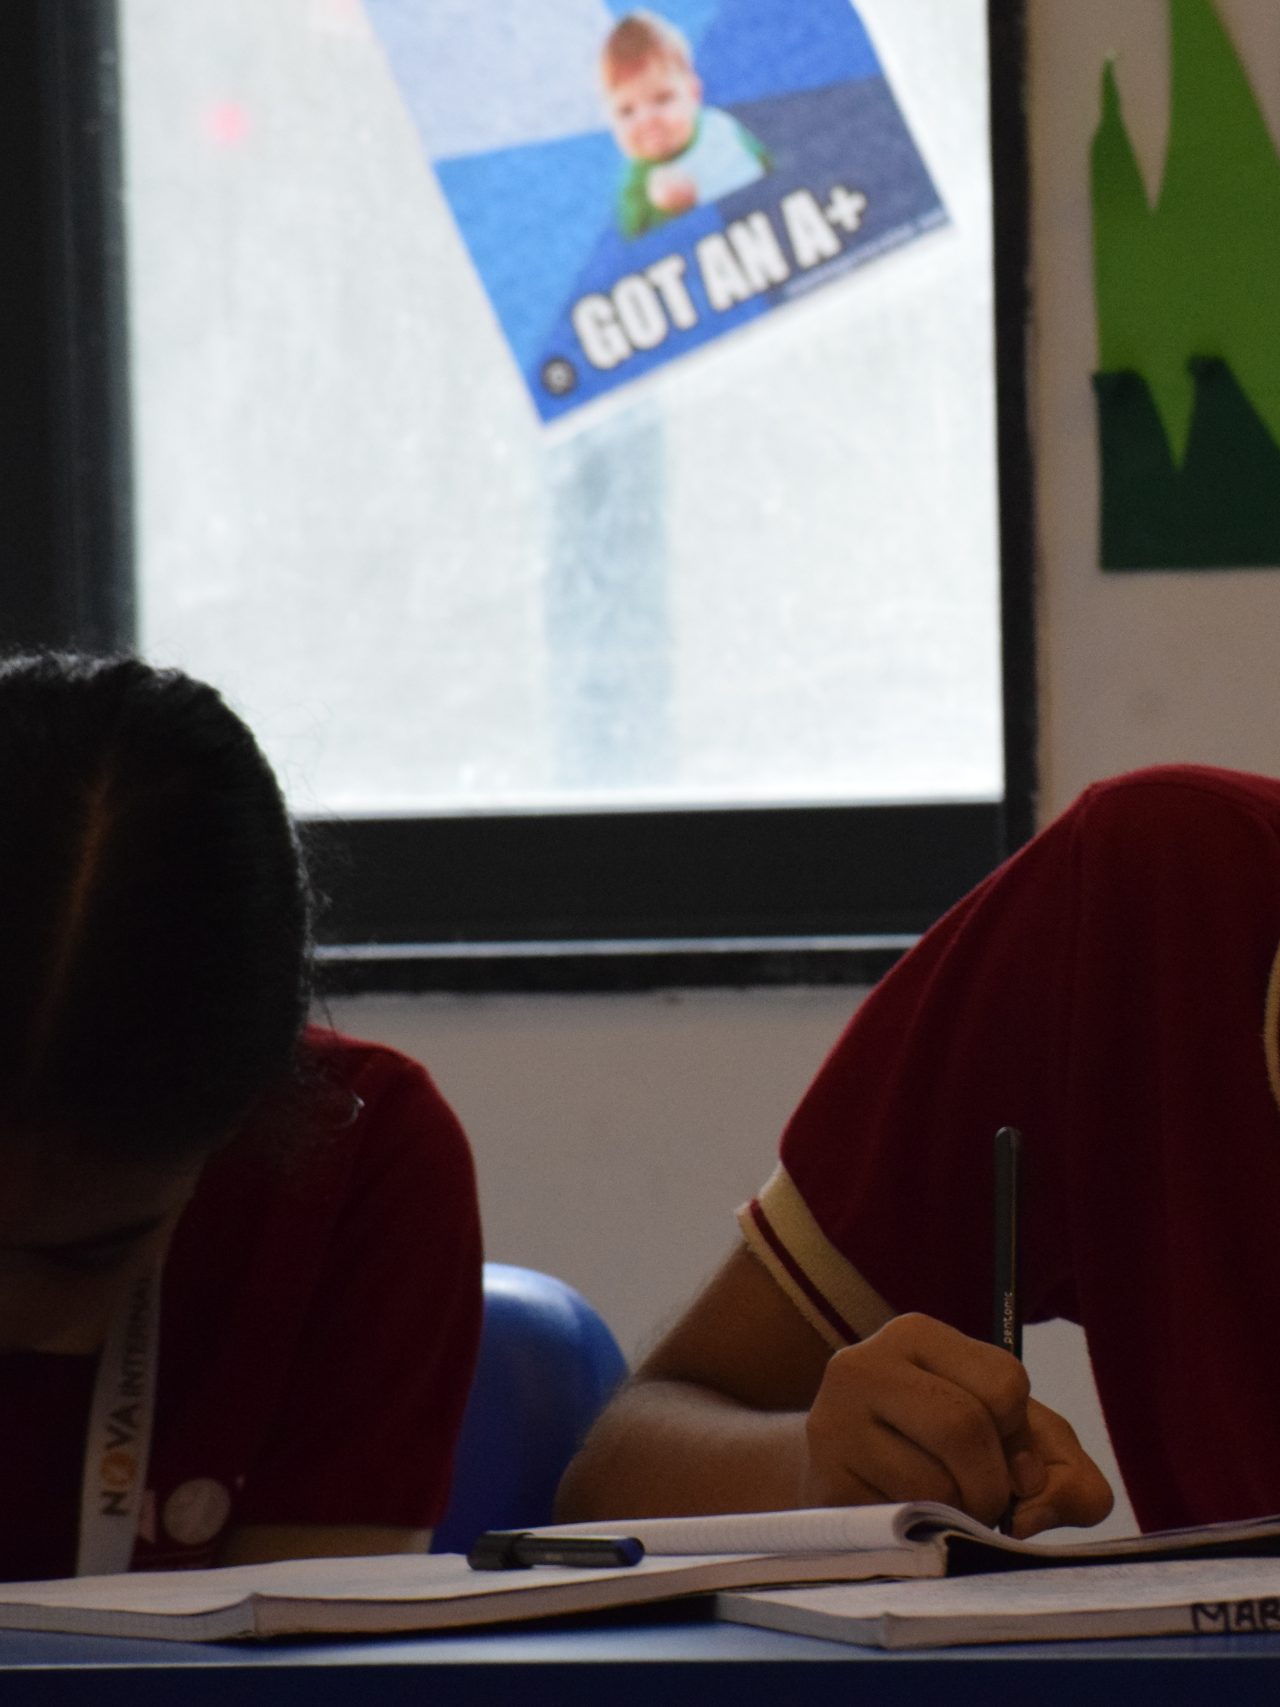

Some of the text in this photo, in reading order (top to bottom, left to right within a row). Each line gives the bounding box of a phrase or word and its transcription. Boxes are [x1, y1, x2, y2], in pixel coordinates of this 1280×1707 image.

[572, 254, 698, 370] GOT
[696, 211, 791, 312] AN
[781, 185, 868, 269] A+
[99, 1403, 141, 1516] NOVA
